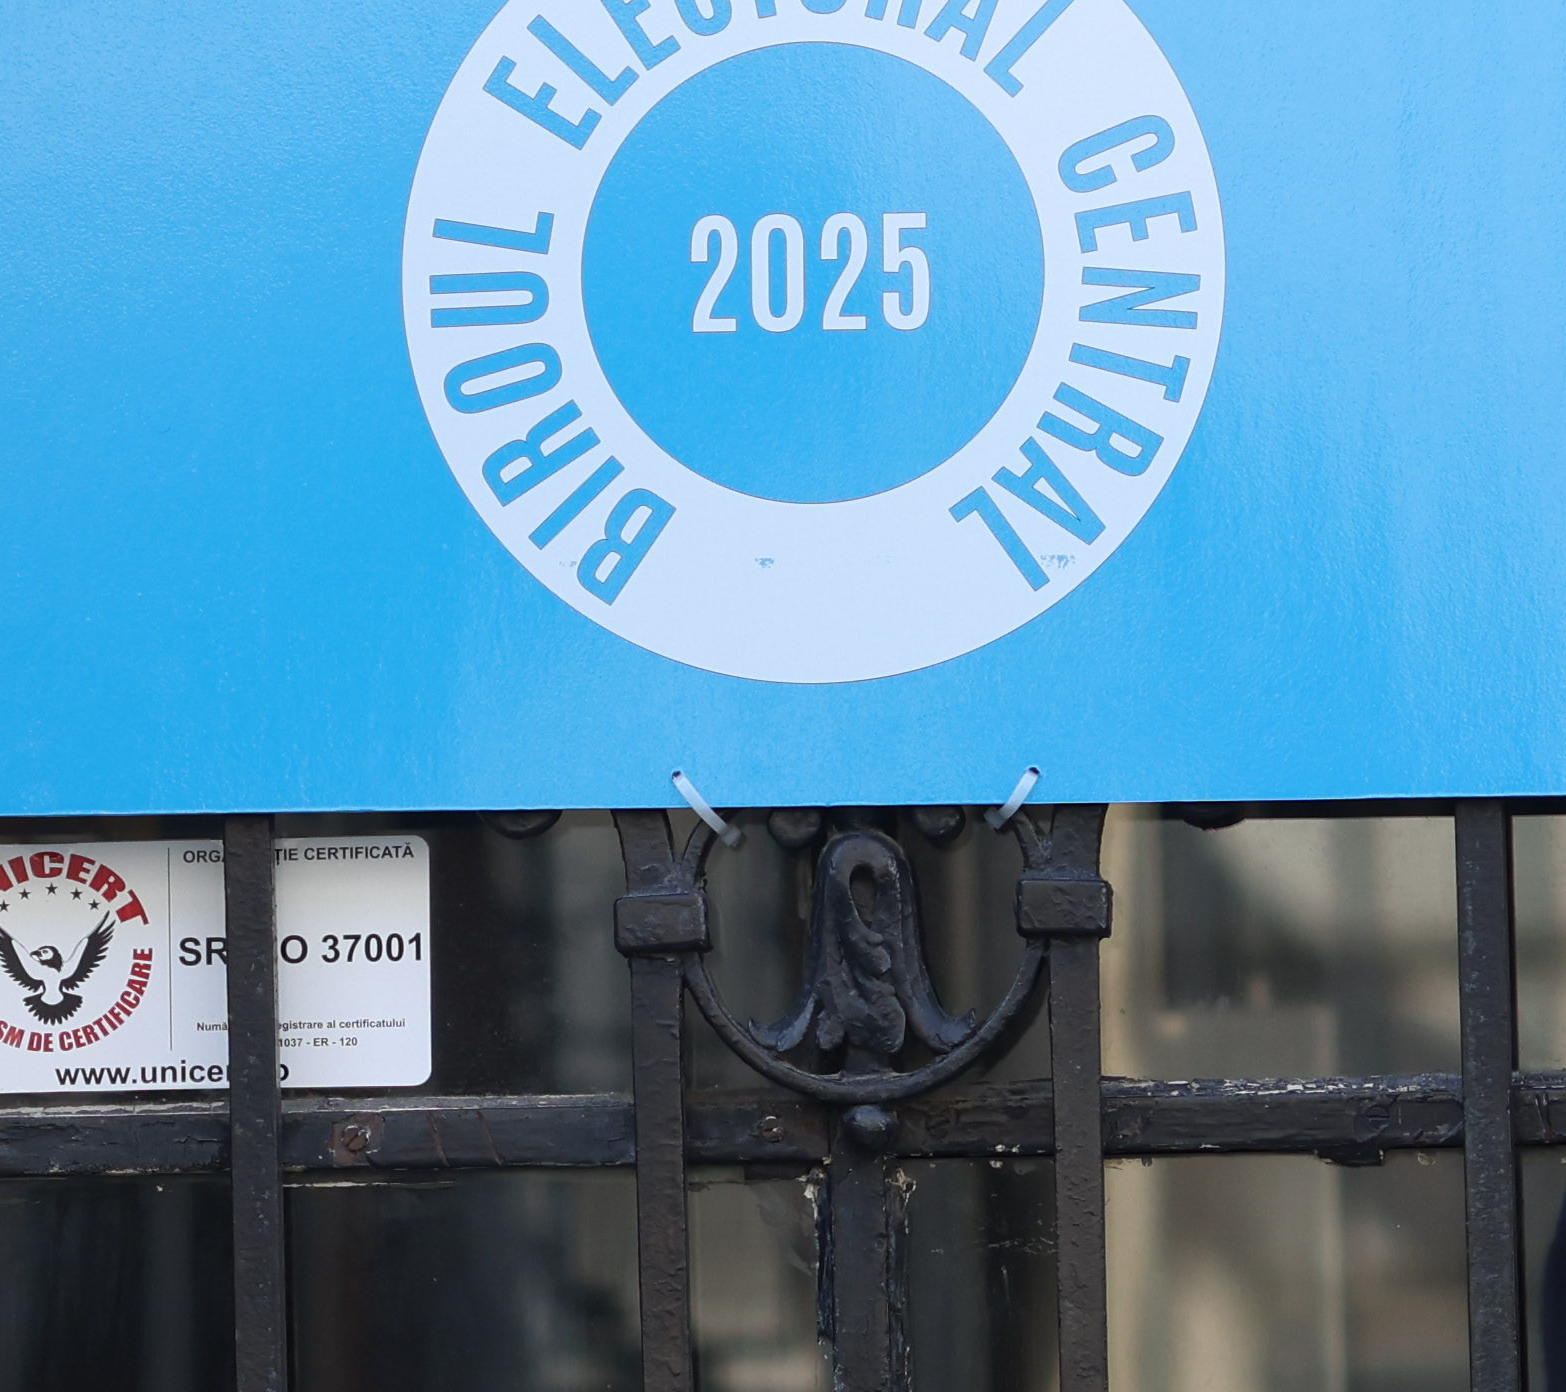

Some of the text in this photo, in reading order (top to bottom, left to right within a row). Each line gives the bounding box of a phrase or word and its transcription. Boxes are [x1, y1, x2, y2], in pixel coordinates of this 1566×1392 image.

[689, 211, 931, 334] 2025
[429, 211, 677, 606] BIROUL
[947, 114, 1201, 592] CENTRAL
[182, 841, 415, 866] ORGȚIE CERTIFICATĂ
[320, 932, 422, 963] 37001
[27, 1031, 54, 1052] DE
[58, 947, 153, 1052] CERTIFICARE
[196, 1021, 228, 1032] Numă
[326, 1019, 336, 1029] al
[338, 1018, 406, 1029] certificatului
[313, 1037, 329, 1047] ER
[340, 1037, 358, 1047] 120
